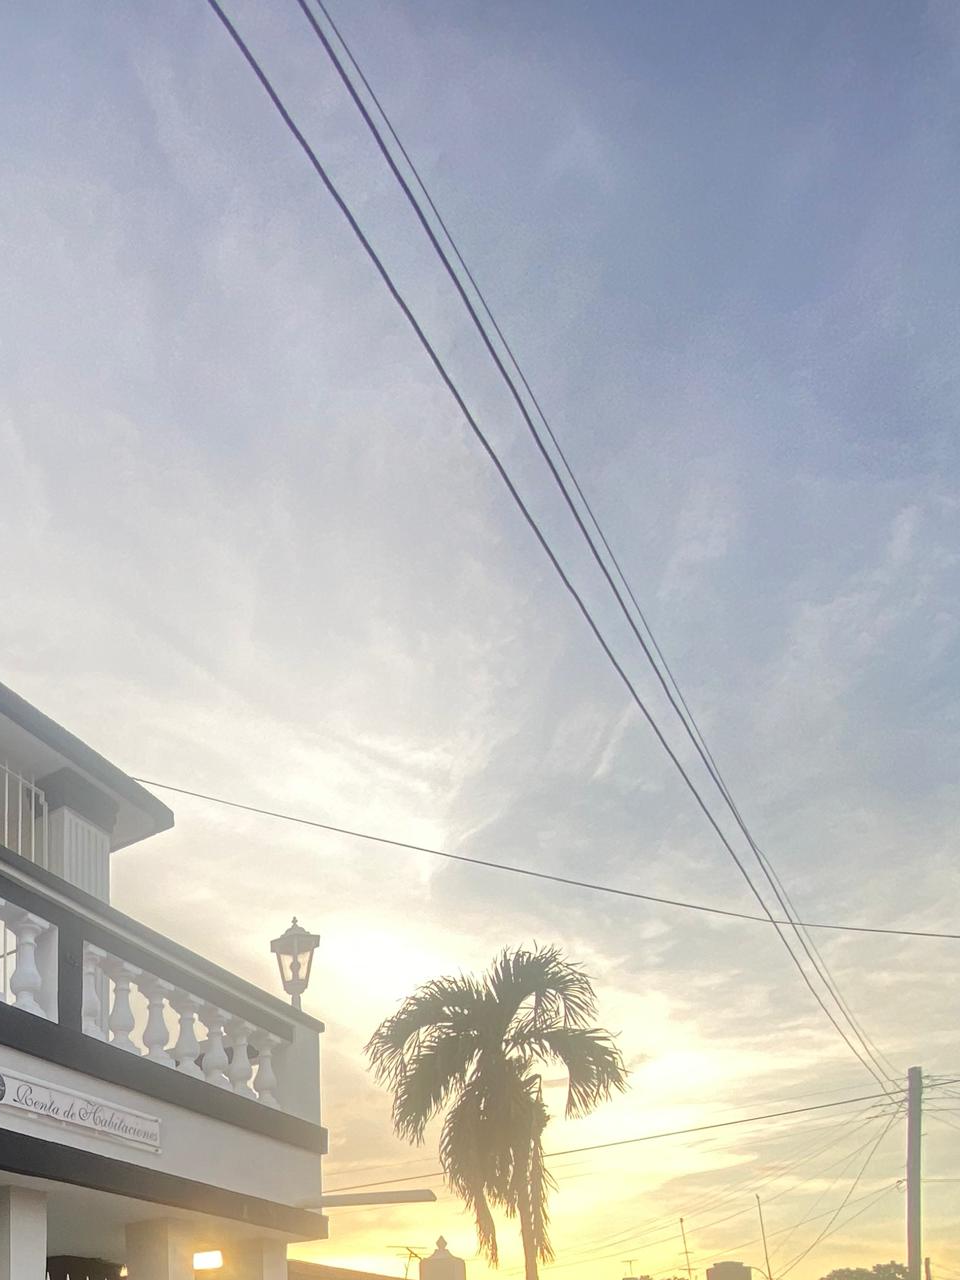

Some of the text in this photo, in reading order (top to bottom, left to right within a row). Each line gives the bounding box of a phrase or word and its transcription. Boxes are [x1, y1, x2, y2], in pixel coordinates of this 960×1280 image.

[13, 1084, 60, 1116] Renta
[63, 1103, 76, 1119] de
[78, 1101, 158, 1142] Habitaciones
